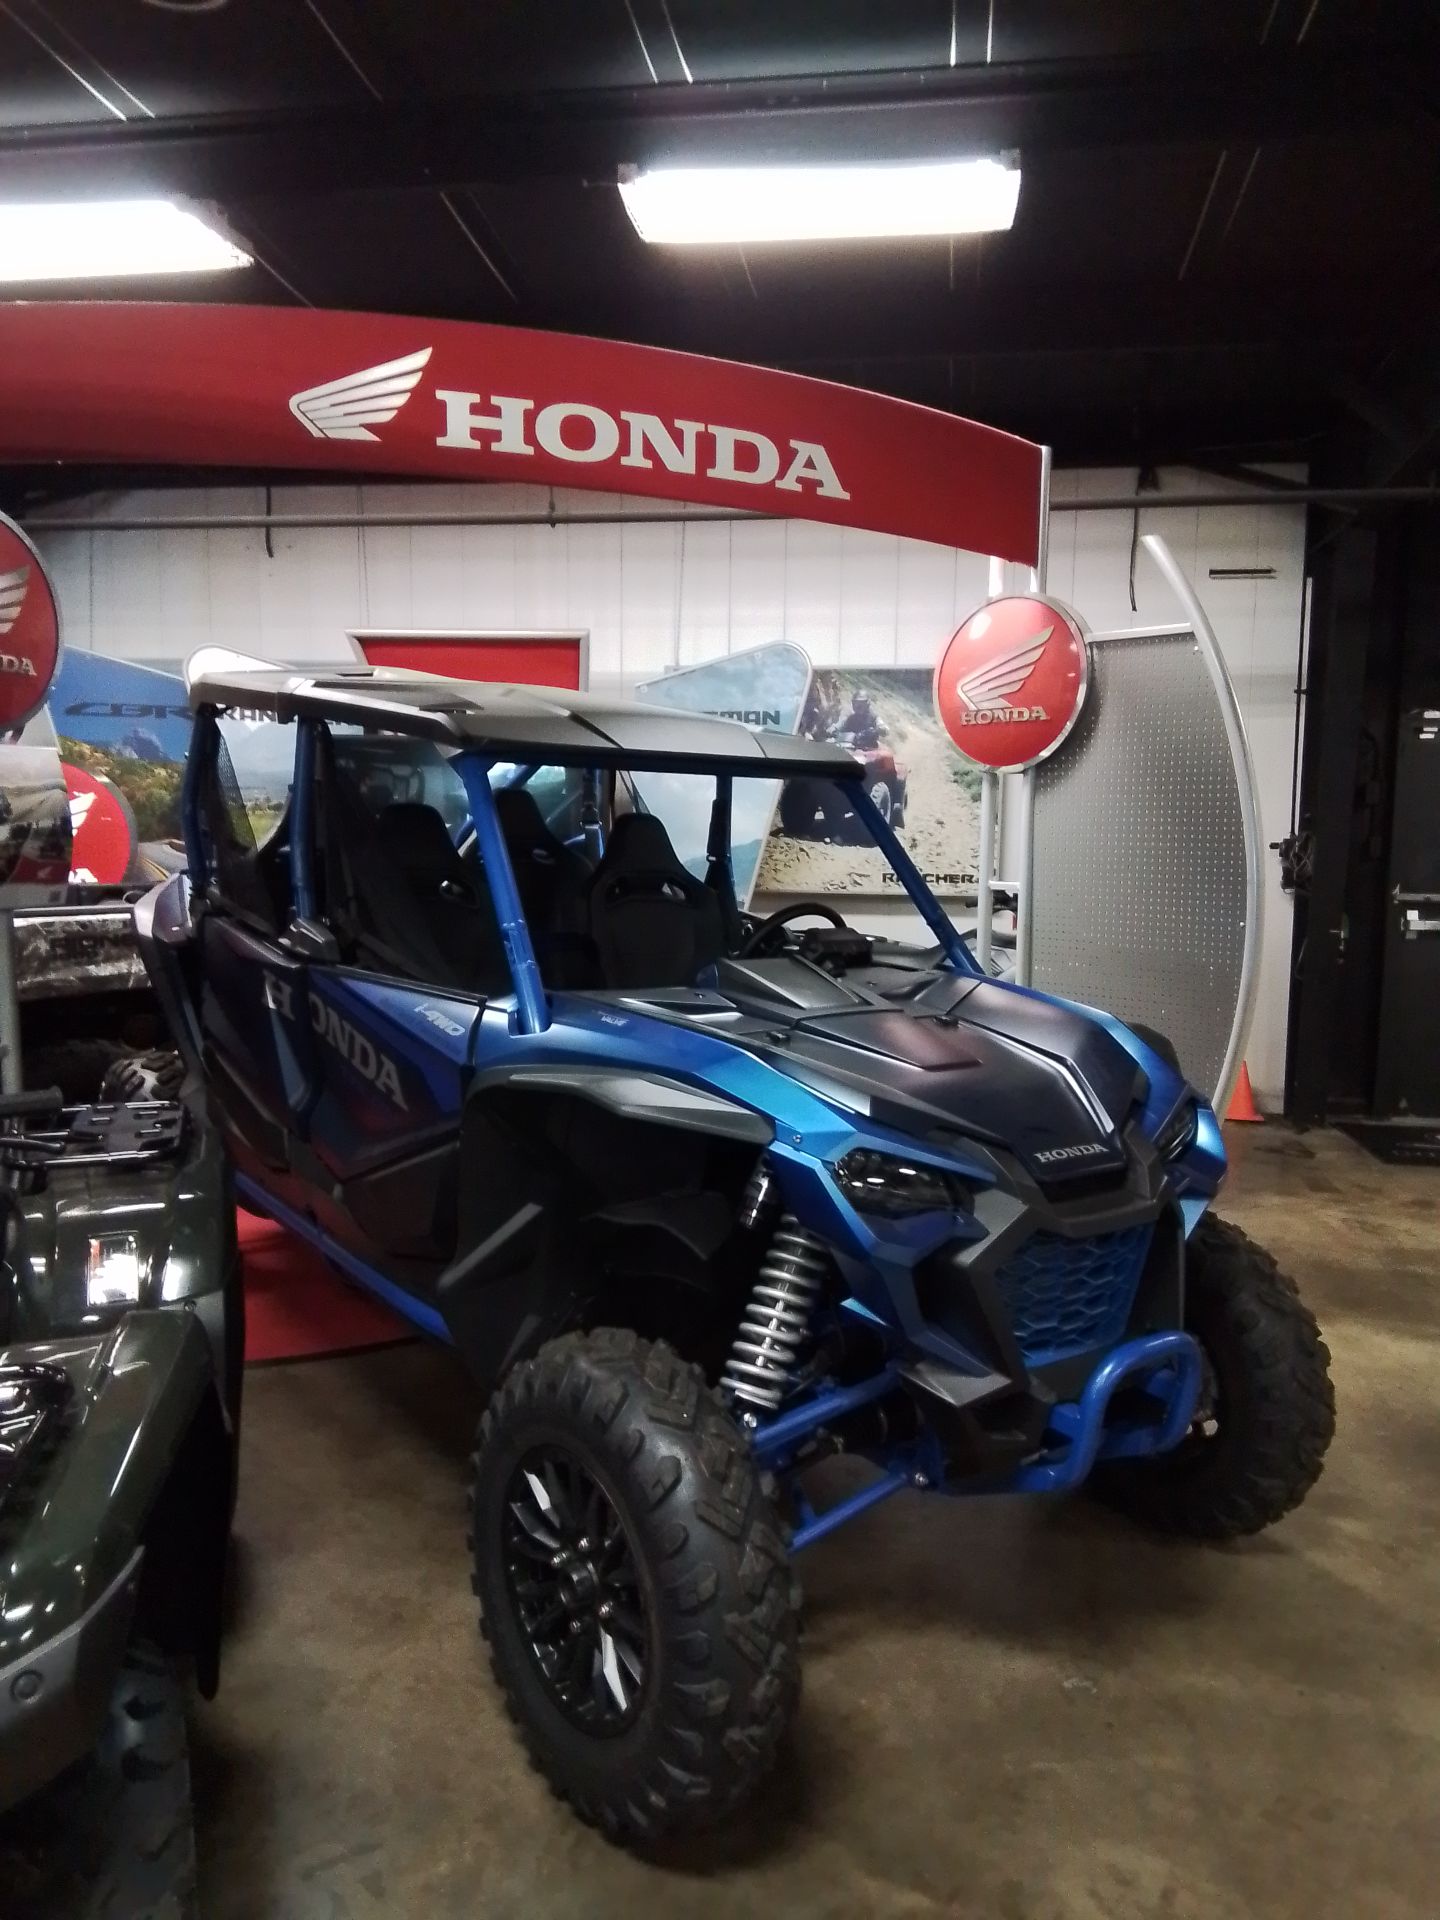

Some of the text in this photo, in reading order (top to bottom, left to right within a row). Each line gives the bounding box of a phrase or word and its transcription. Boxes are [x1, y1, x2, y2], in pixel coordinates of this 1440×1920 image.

[436, 389, 850, 500] HONDA
[0, 654, 38, 677] DA
[960, 705, 1050, 726] HONDA
[882, 872, 976, 885] RCHER
[1035, 1143, 1109, 1163] HONDA
